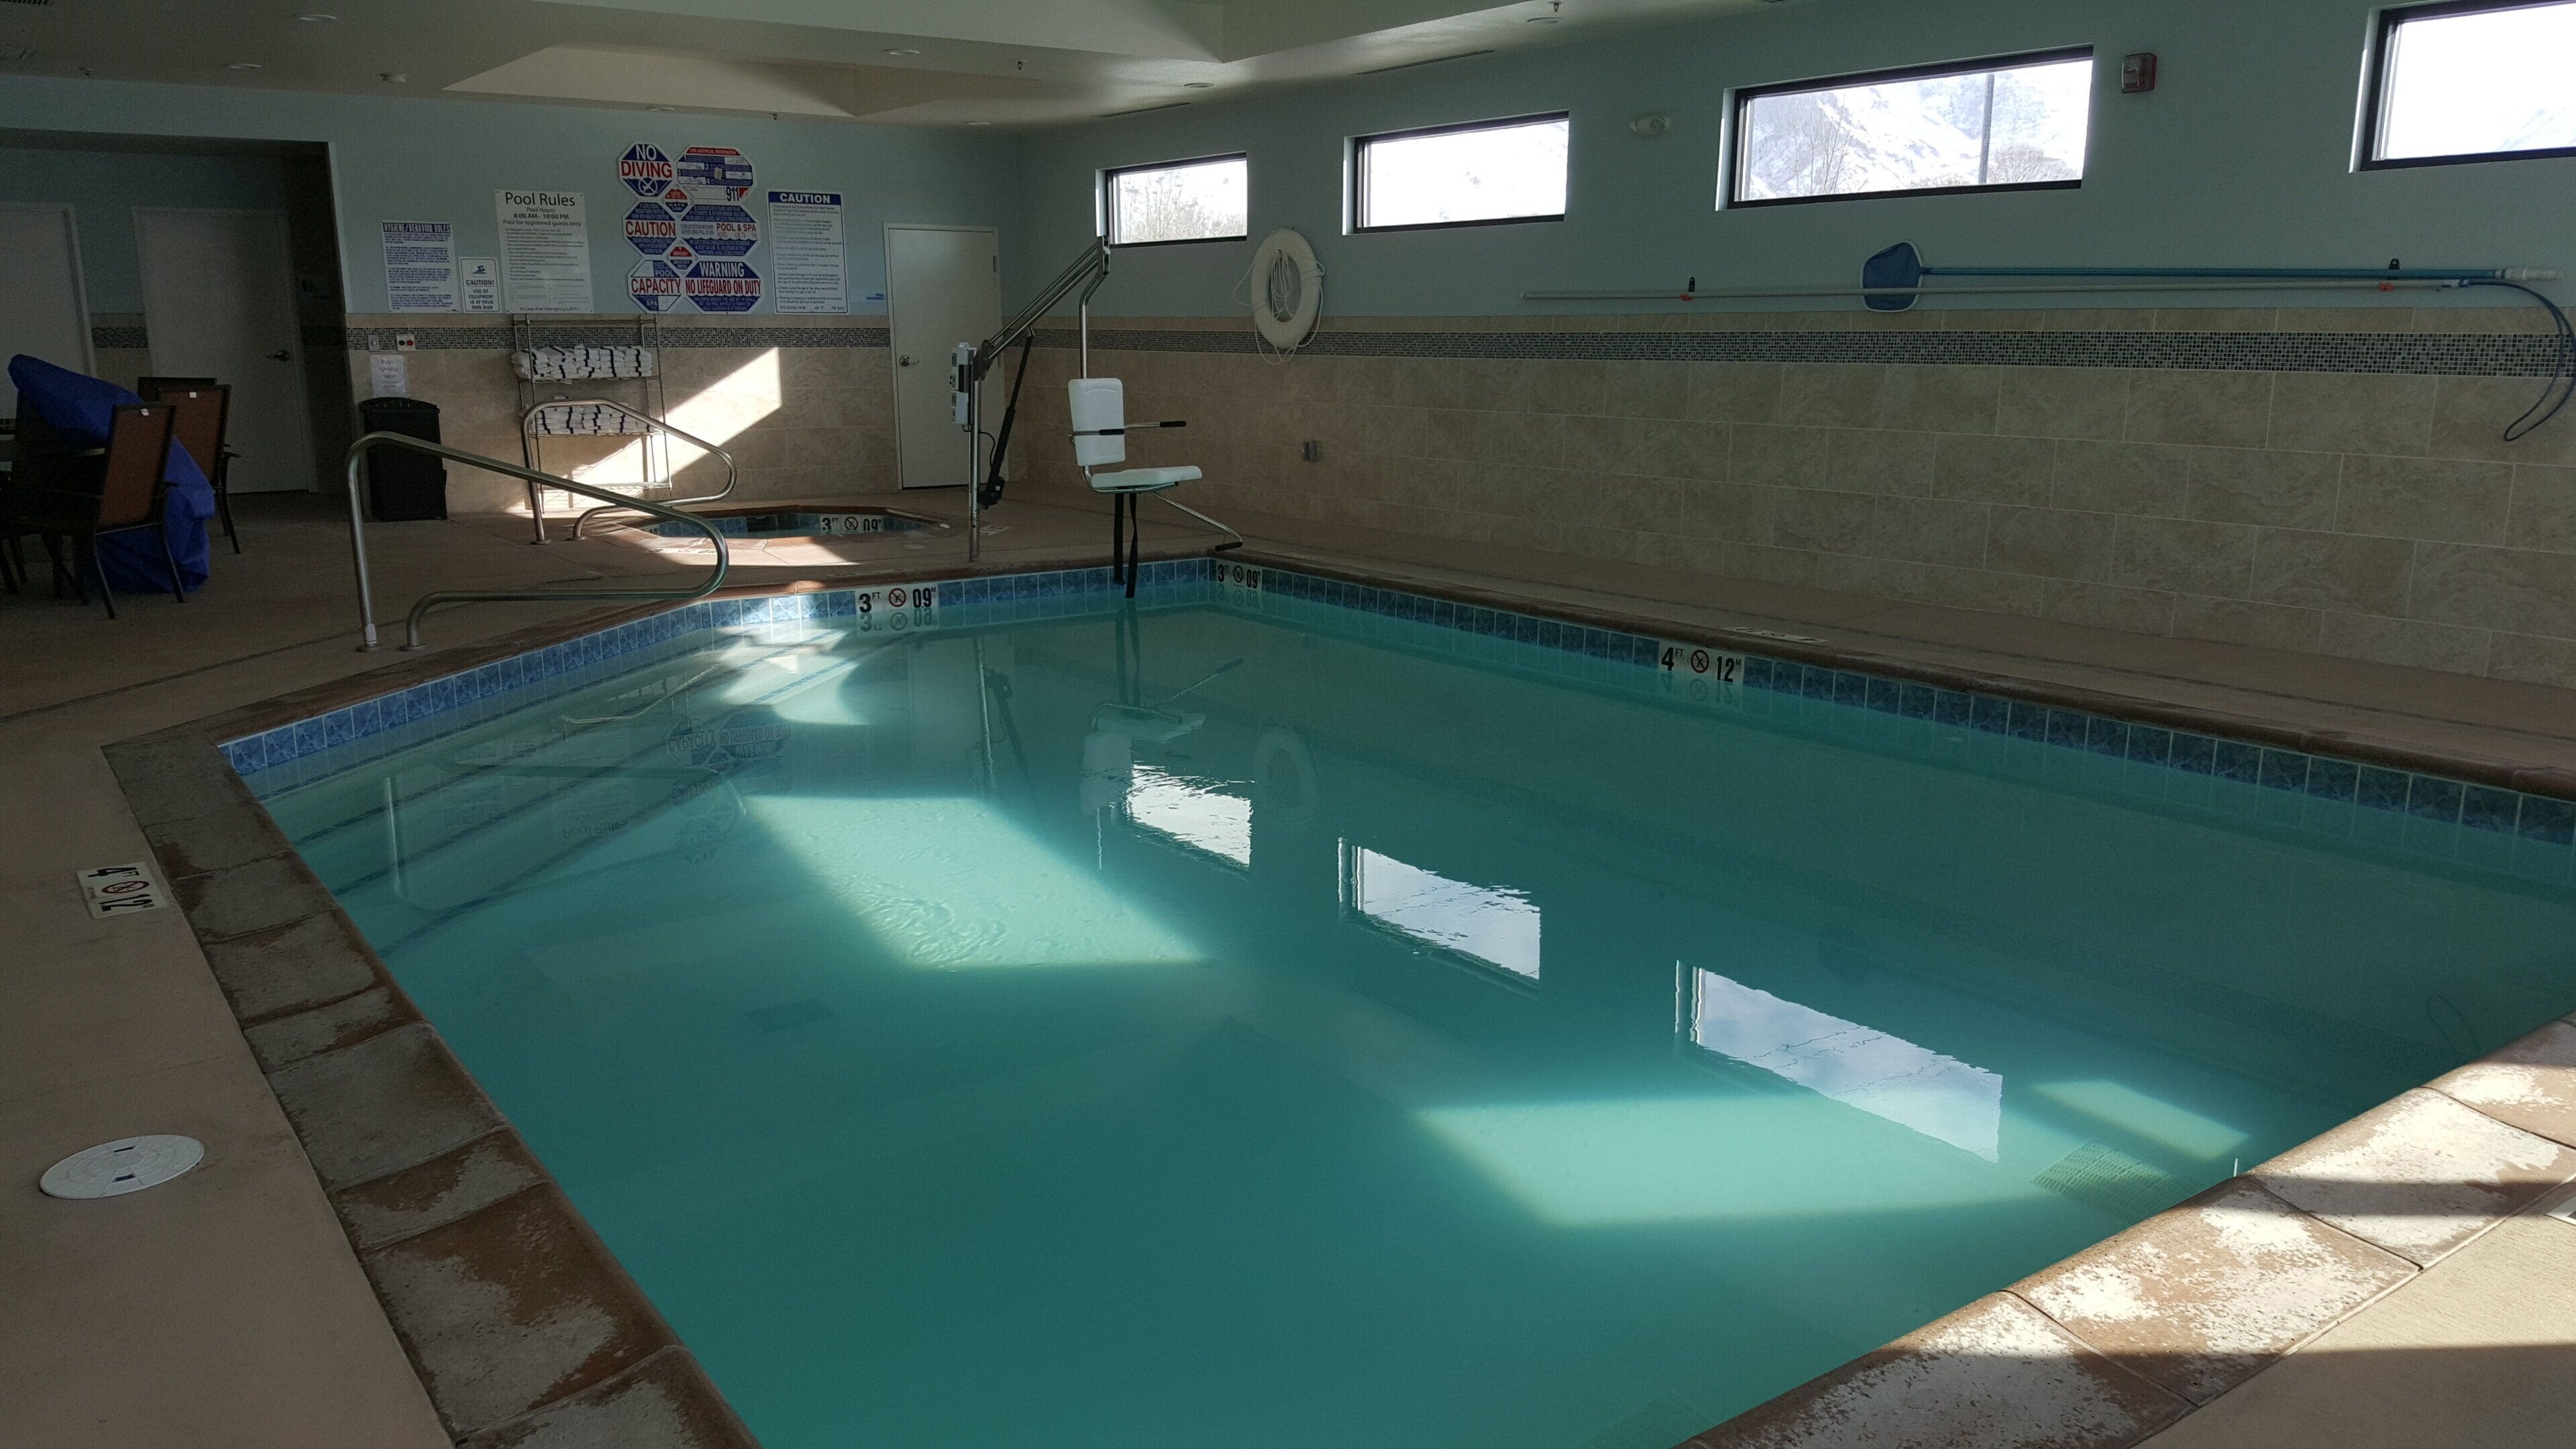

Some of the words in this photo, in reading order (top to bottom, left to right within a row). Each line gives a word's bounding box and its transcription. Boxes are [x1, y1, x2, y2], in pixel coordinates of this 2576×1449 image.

[636, 144, 657, 160] NO
[621, 161, 672, 178] DIVING
[504, 192, 535, 205] Pool
[539, 193, 576, 206] Rules
[726, 186, 739, 201] 911
[780, 193, 830, 204] CAUTION
[625, 221, 676, 235] CAUTION
[716, 223, 735, 231] POOL
[737, 223, 741, 231] &
[743, 223, 757, 232] SPA
[699, 262, 745, 278] WARNING
[631, 278, 681, 294] CAPACITY
[685, 280, 696, 294] NO
[698, 280, 731, 294] LIFEGUARD
[733, 280, 743, 294] ON
[745, 280, 761, 294] DUTY
